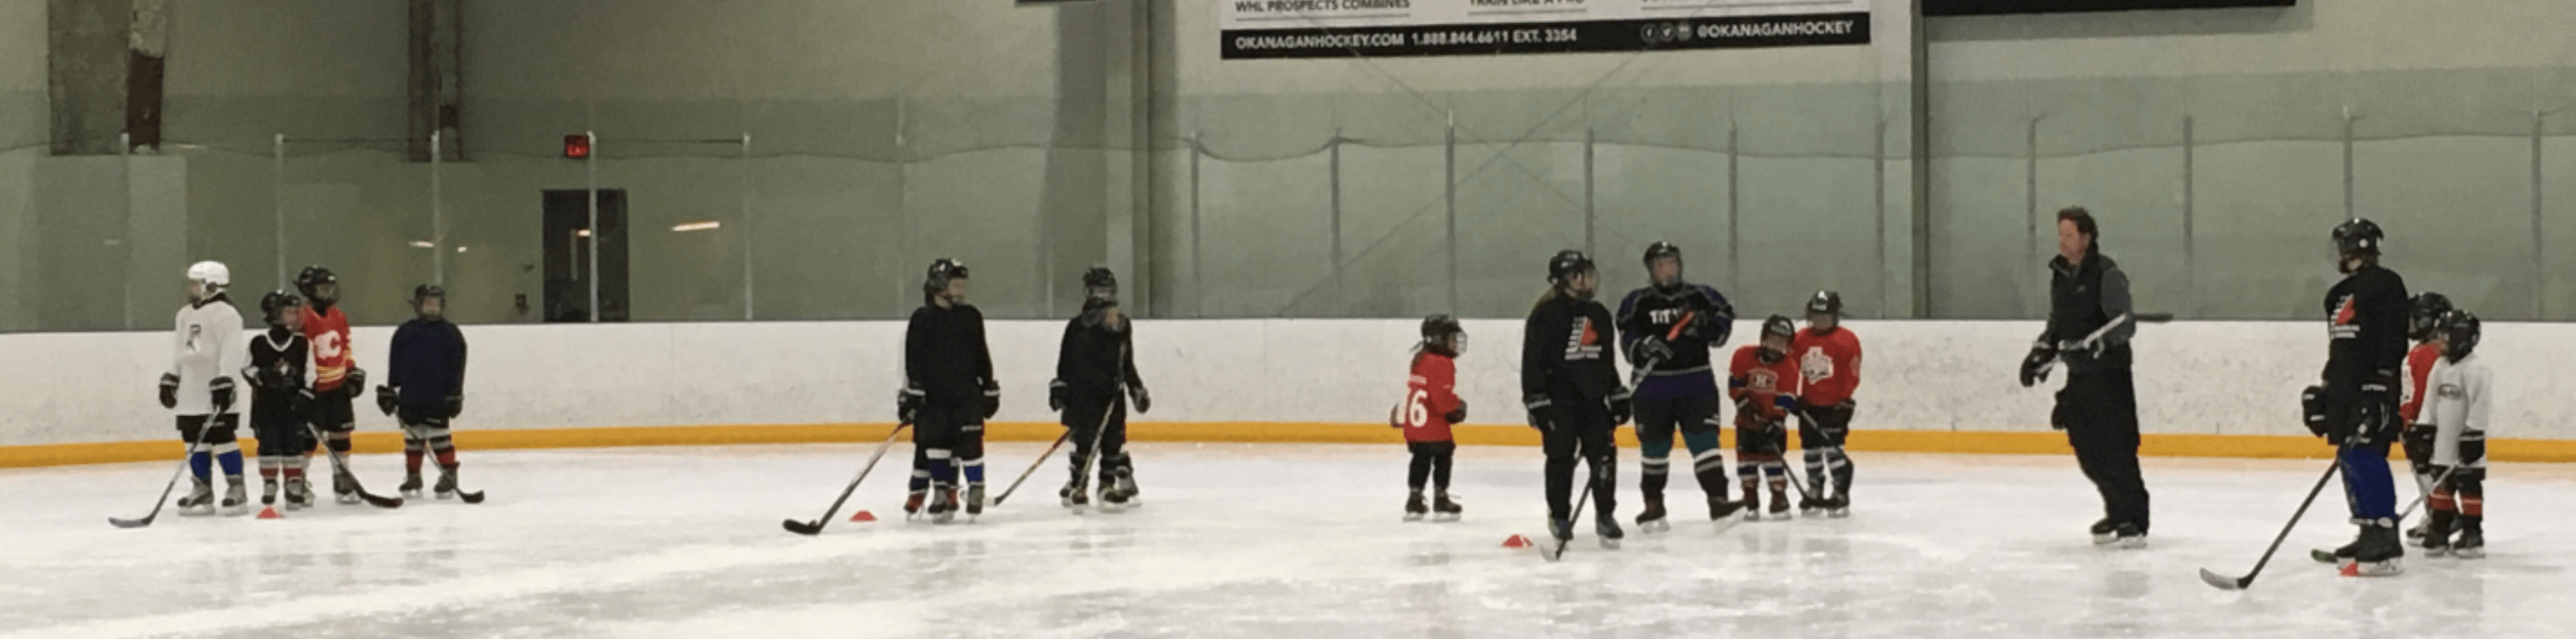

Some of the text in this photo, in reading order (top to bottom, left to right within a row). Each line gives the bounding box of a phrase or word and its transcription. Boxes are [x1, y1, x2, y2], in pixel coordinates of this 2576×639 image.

[1235, 0, 1410, 12] WHL PROSPECTS COMBINES
[1697, 19, 1854, 38] @OKANAGANHOCKEY
[1235, 28, 1577, 50] OKANAGANHOCKEY.COM 1.888.844.6611 EXT. 3354
